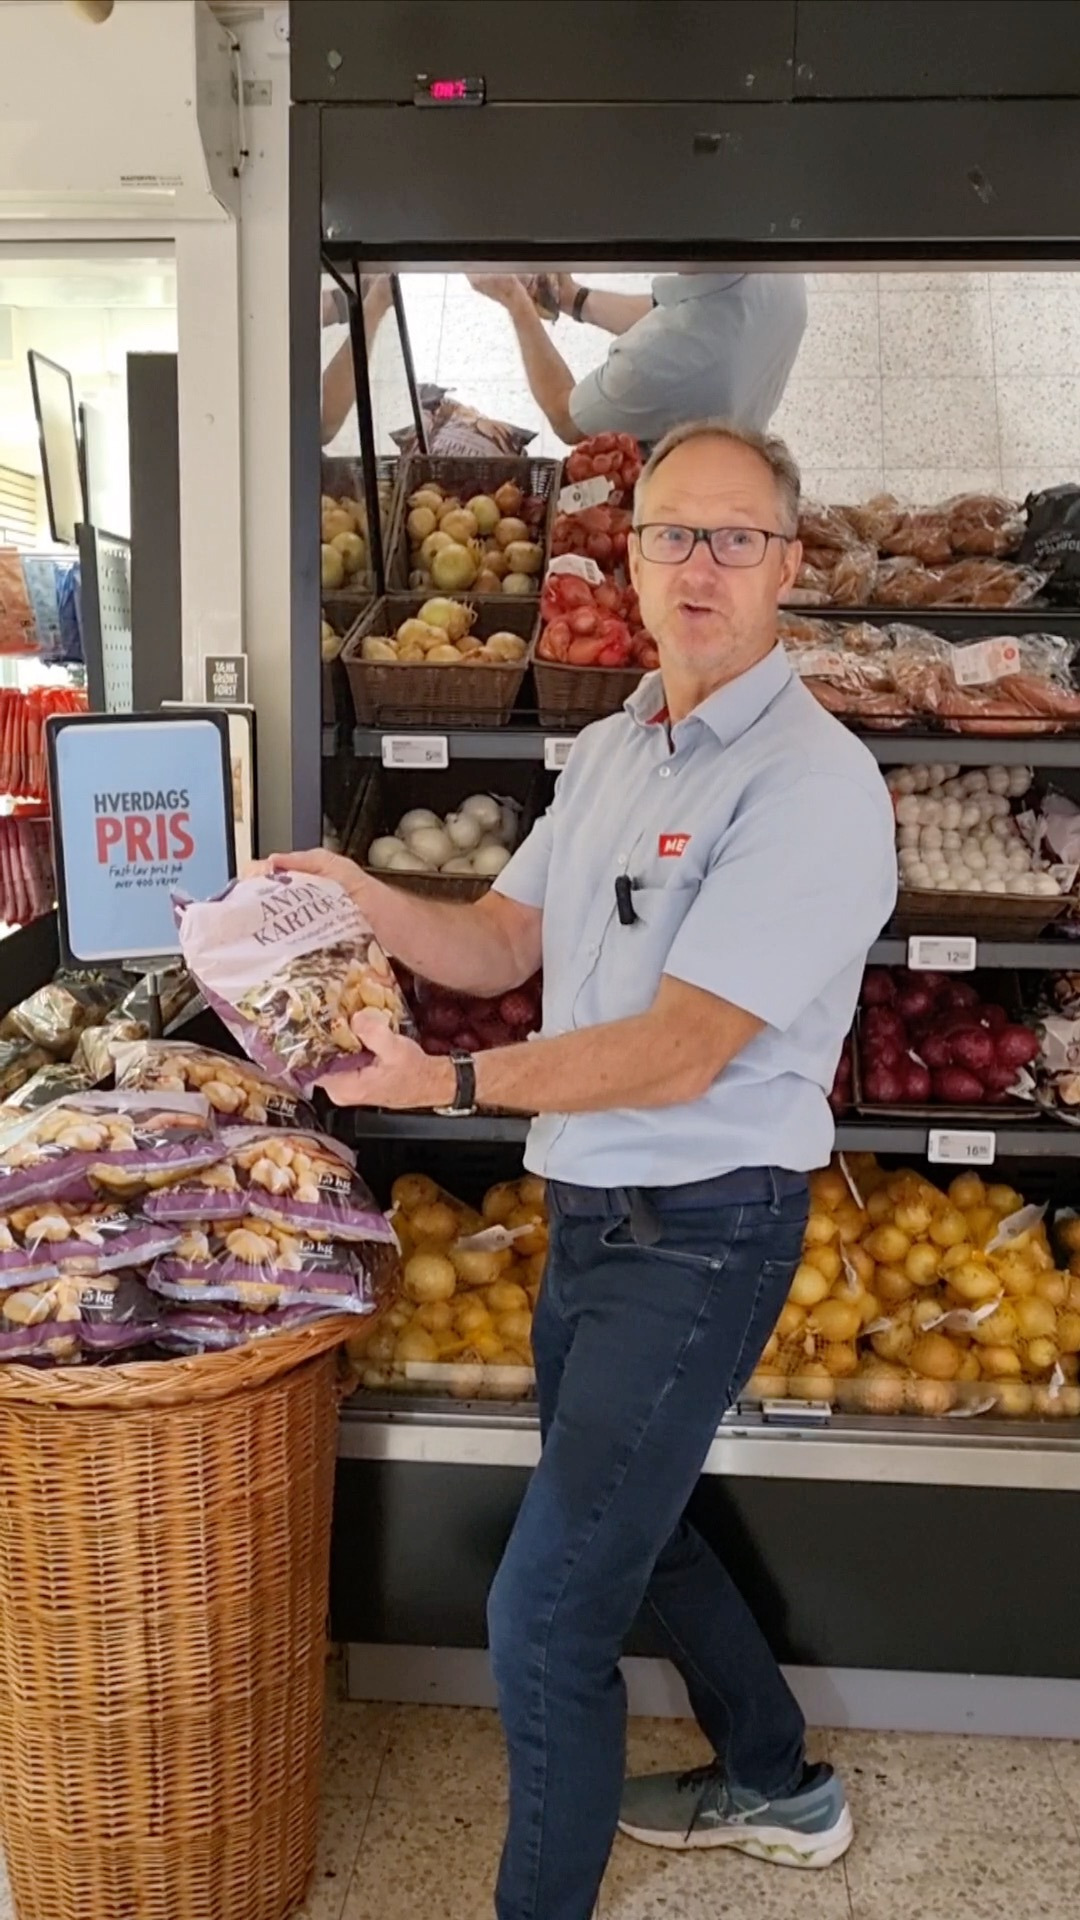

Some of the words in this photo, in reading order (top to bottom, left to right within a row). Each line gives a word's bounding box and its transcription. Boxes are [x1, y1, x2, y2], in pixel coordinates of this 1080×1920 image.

[94, 789, 190, 813] HVERDAGS
[96, 812, 194, 864] PRIS
[109, 864, 130, 878] Fast
[115, 880, 134, 889] over
[96, 1290, 115, 1306] kg
